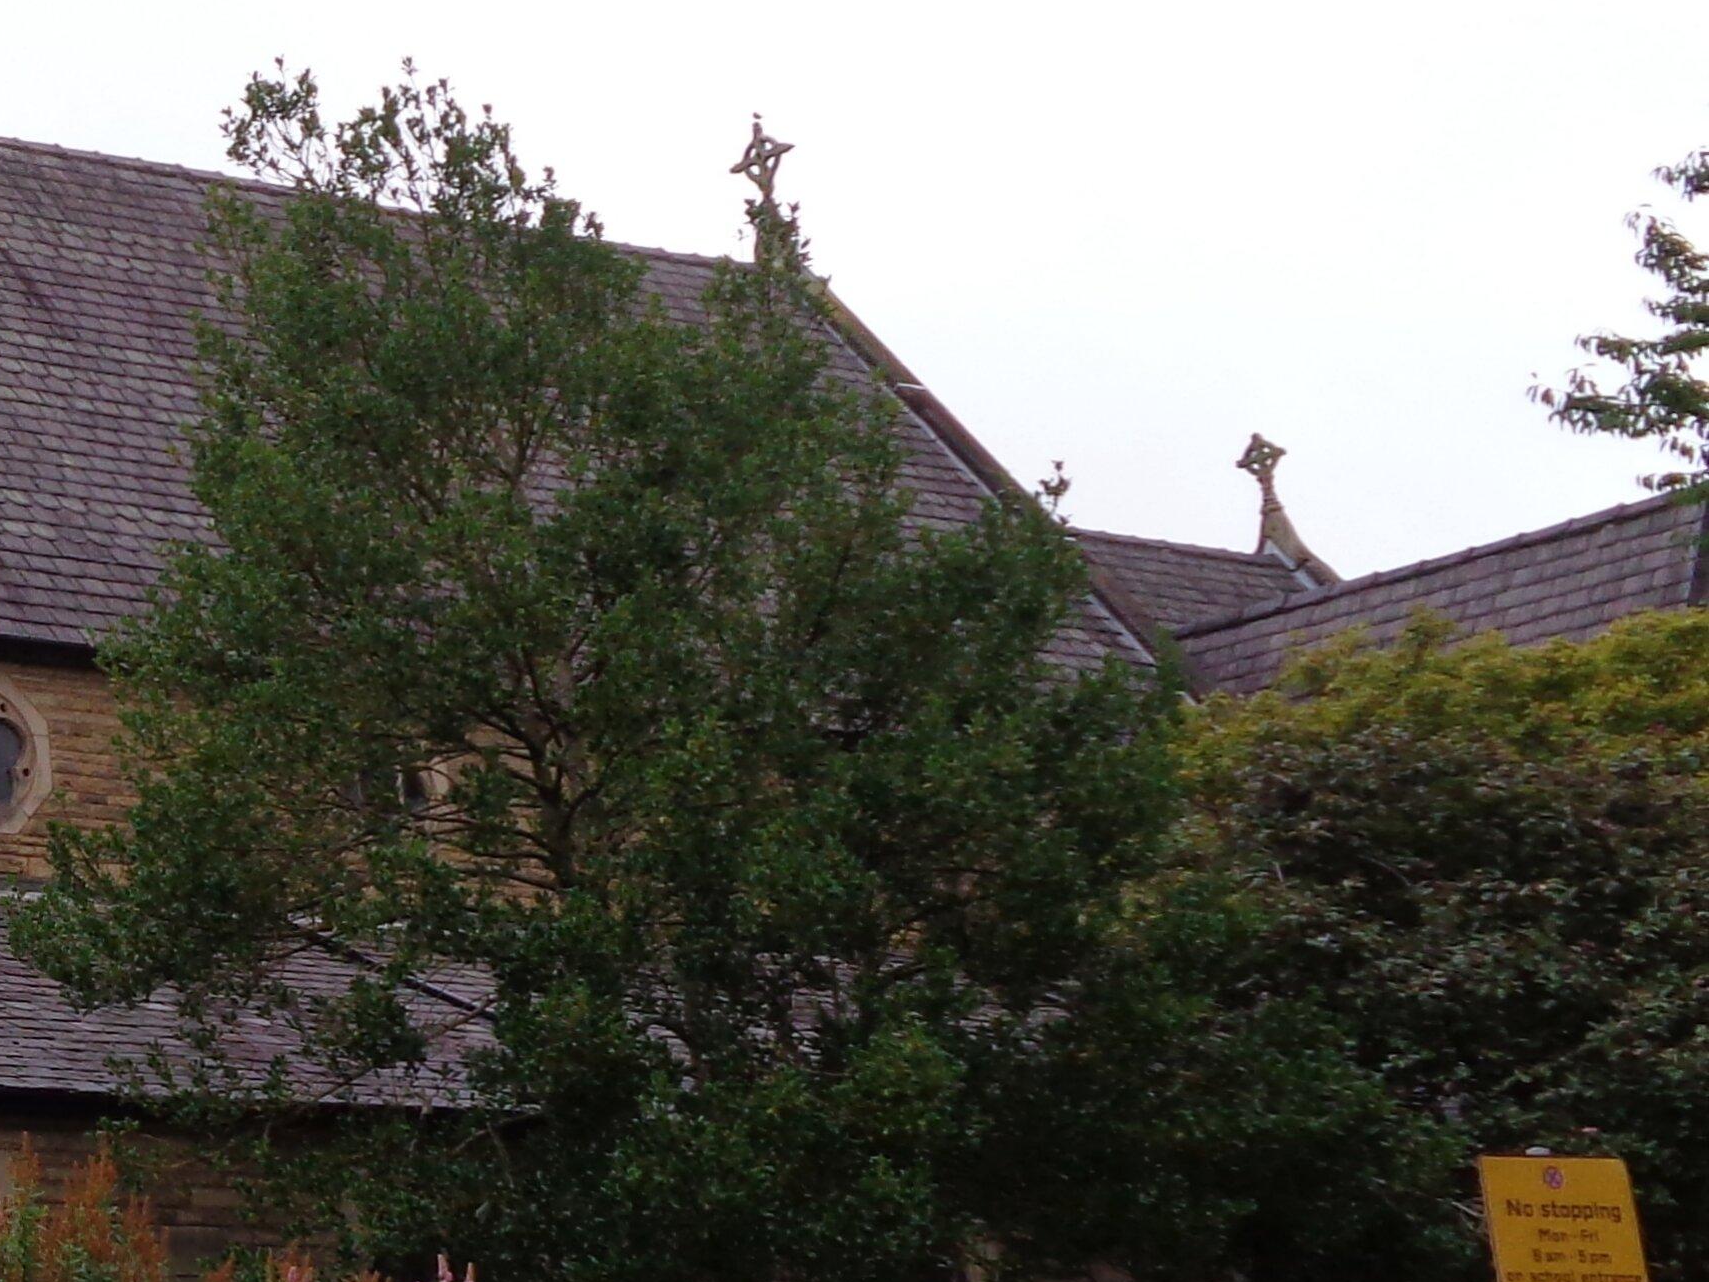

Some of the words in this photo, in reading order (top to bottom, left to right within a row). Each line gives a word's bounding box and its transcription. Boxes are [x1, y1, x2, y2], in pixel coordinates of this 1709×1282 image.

[1506, 1199, 1534, 1218] No
[1540, 1201, 1621, 1223] stopping
[1538, 1228, 1568, 1242] Mon
[1580, 1228, 1599, 1242] Fri
[1507, 1272, 1523, 1282] on
